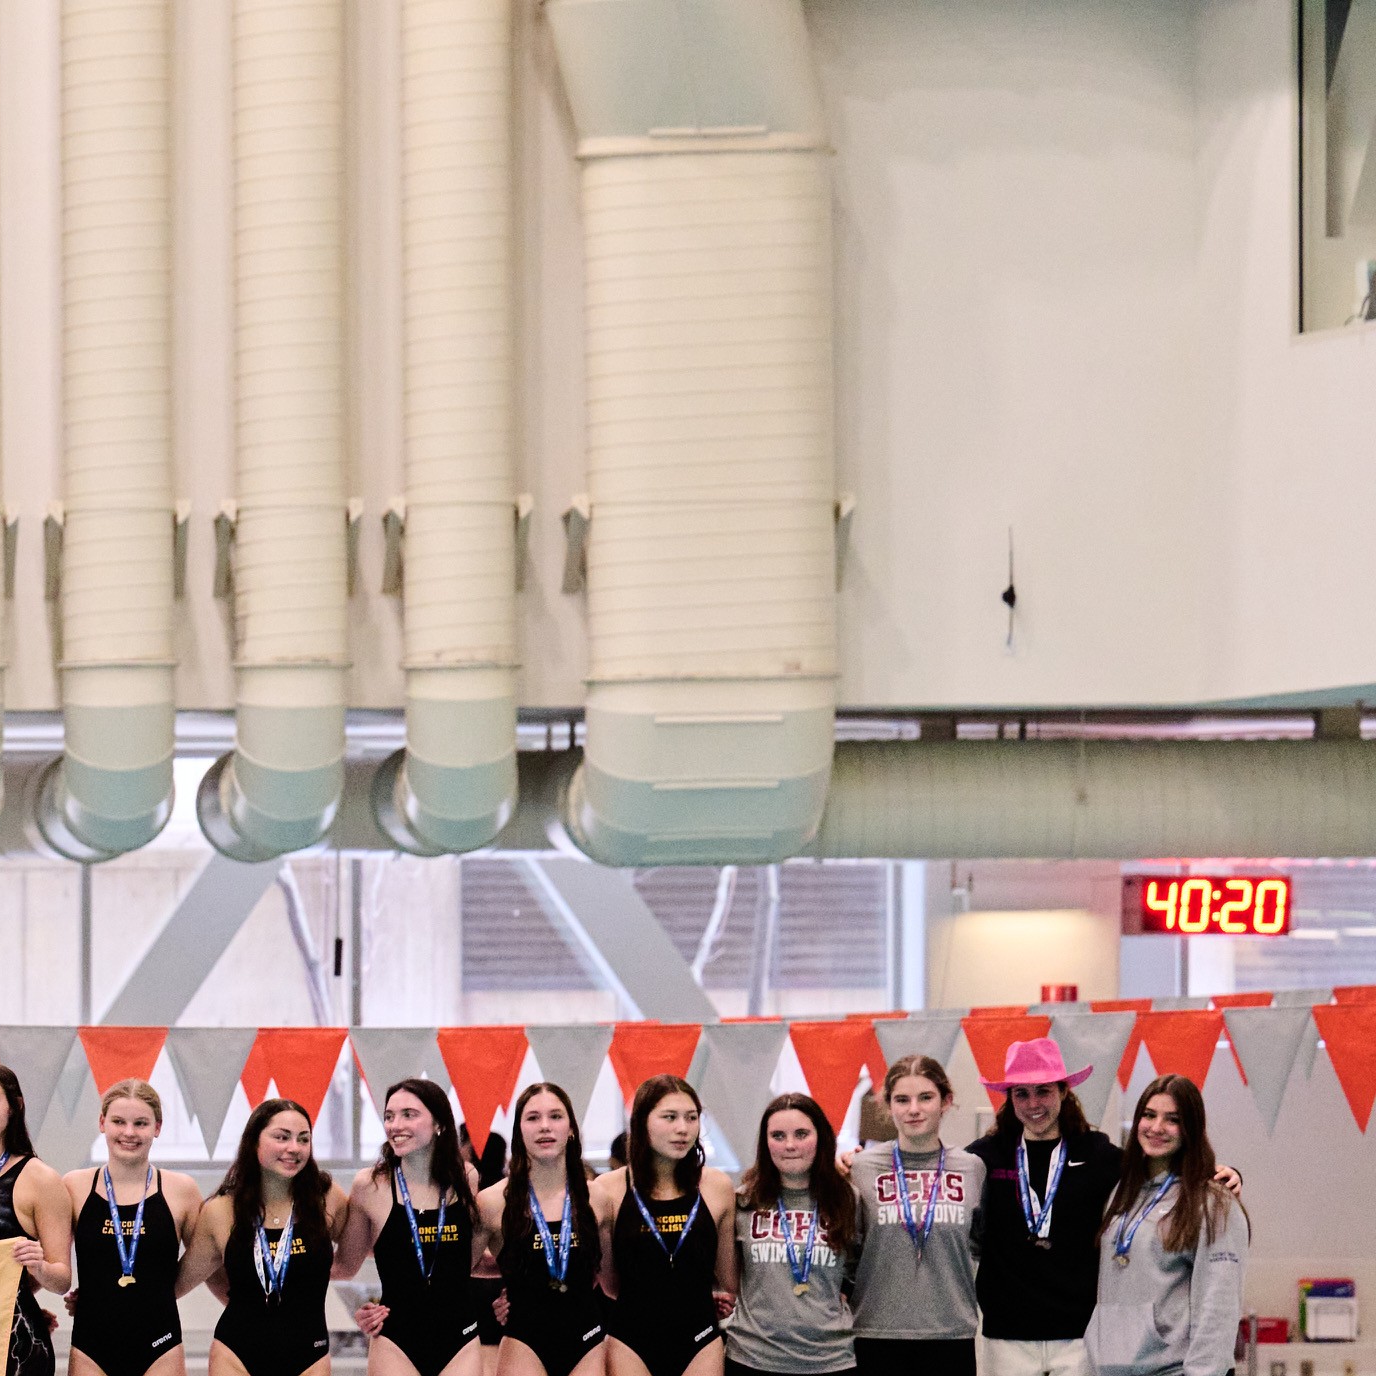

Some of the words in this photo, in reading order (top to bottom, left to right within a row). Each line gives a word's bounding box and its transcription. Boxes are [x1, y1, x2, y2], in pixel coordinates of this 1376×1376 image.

[1147, 878, 1285, 934] 40:20
[875, 1169, 965, 1204] CCHS
[933, 1204, 965, 1225] DIVE
[101, 1226, 146, 1236] CALISE
[104, 1219, 144, 1228] COCO
[418, 1224, 458, 1235] ONCRD
[411, 1233, 459, 1243] ARLSLE
[750, 1242, 788, 1264] SWIM
[151, 1332, 173, 1348] arena
